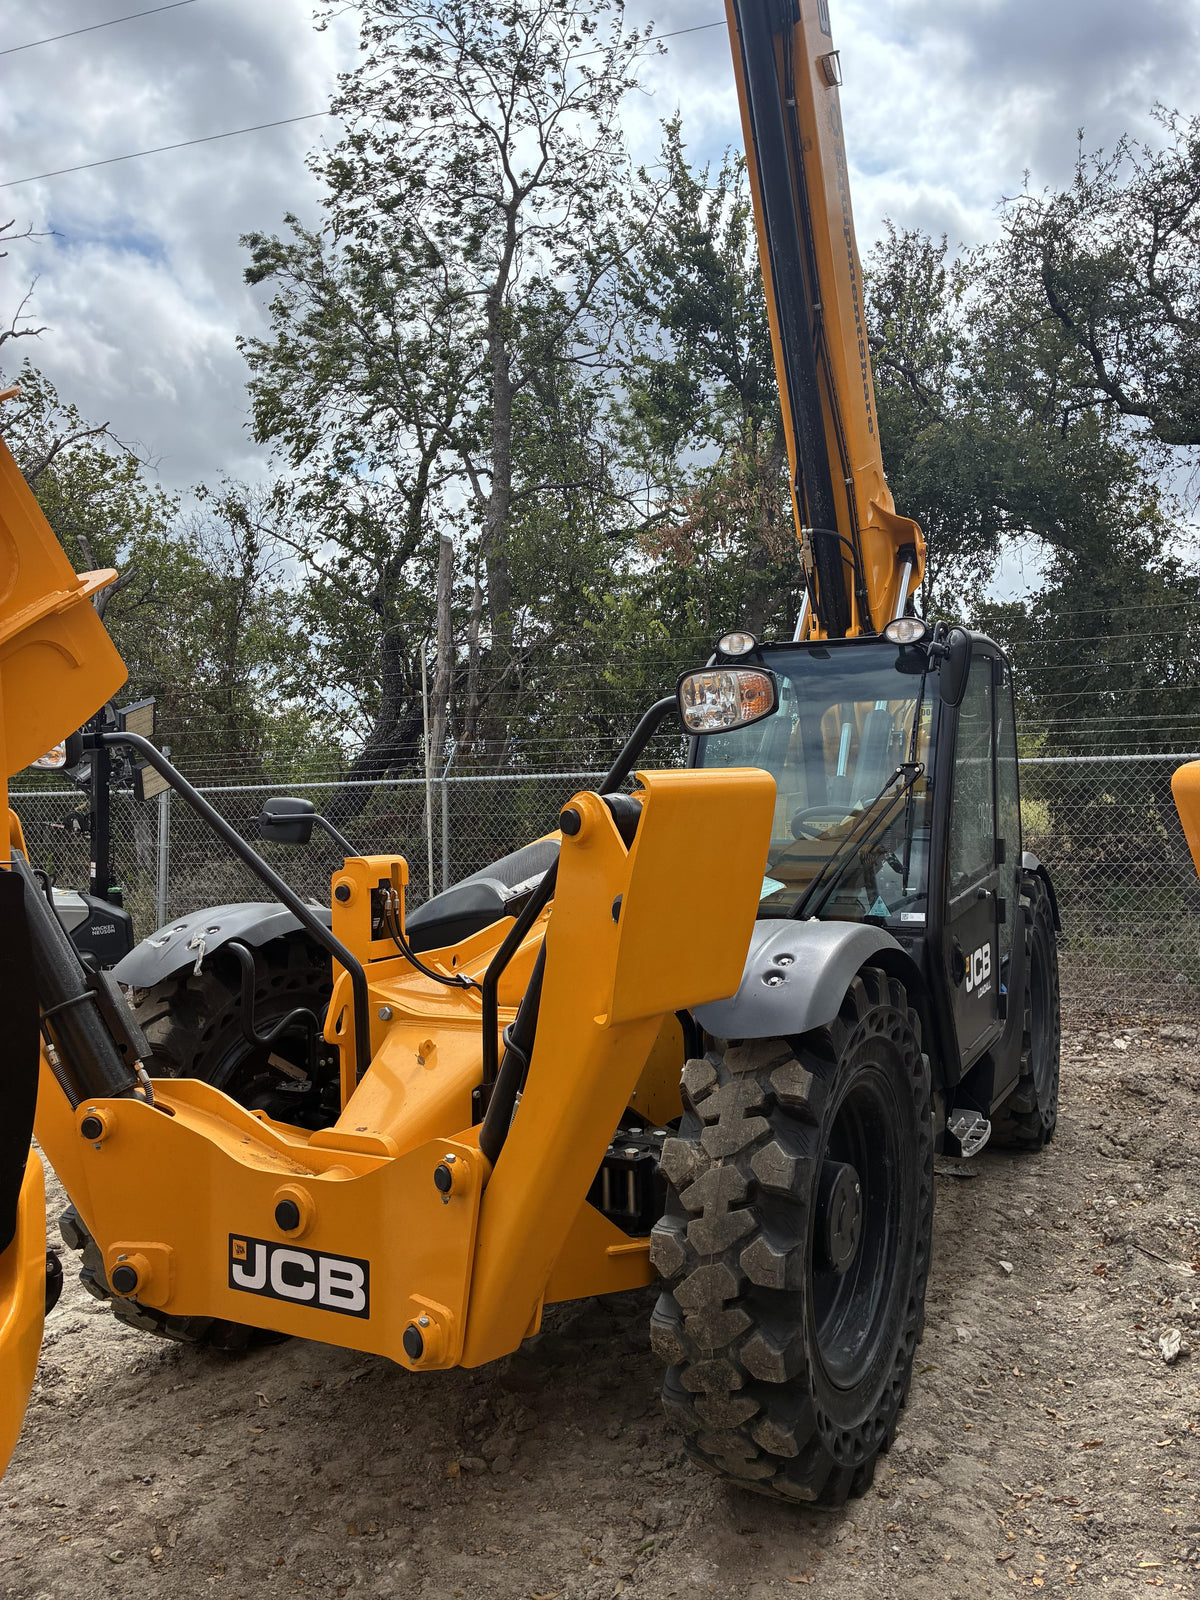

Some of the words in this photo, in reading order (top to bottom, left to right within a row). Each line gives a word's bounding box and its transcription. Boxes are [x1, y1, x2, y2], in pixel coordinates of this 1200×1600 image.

[835, 148, 874, 434] EquipmentShare
[966, 942, 991, 993] JCB
[232, 1243, 366, 1312] JCB
